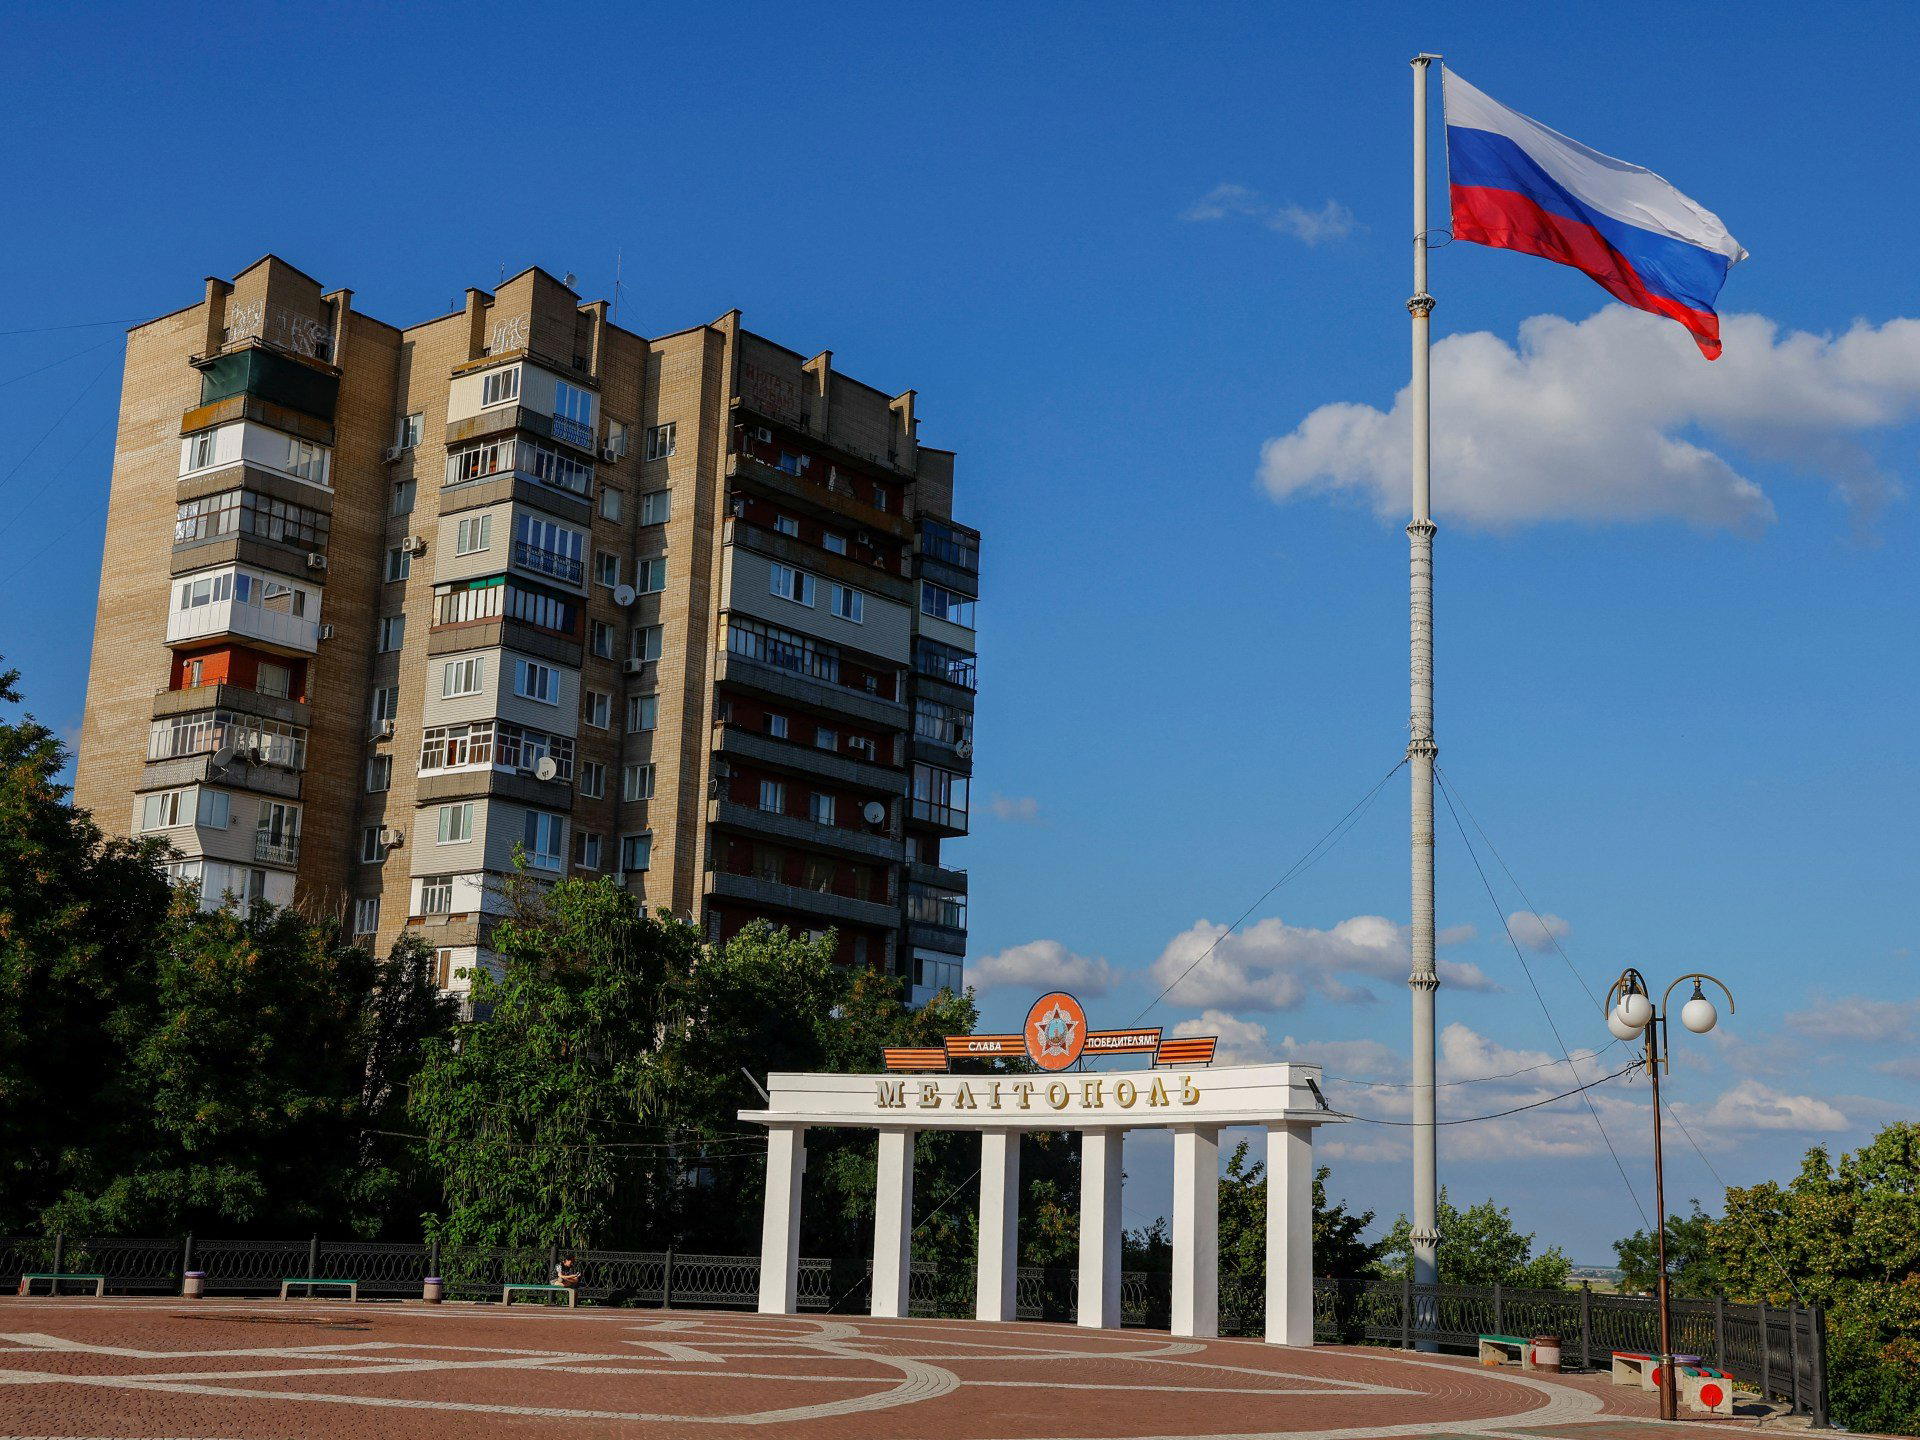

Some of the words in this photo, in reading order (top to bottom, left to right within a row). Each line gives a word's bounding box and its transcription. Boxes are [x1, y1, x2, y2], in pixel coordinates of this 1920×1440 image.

[968, 1040, 1002, 1052] СЛАВА
[1087, 1035, 1155, 1049] ПОБЕДИТЕЛЯМ!
[874, 1075, 1200, 1110] МЕЛІТОПОЛЬ
